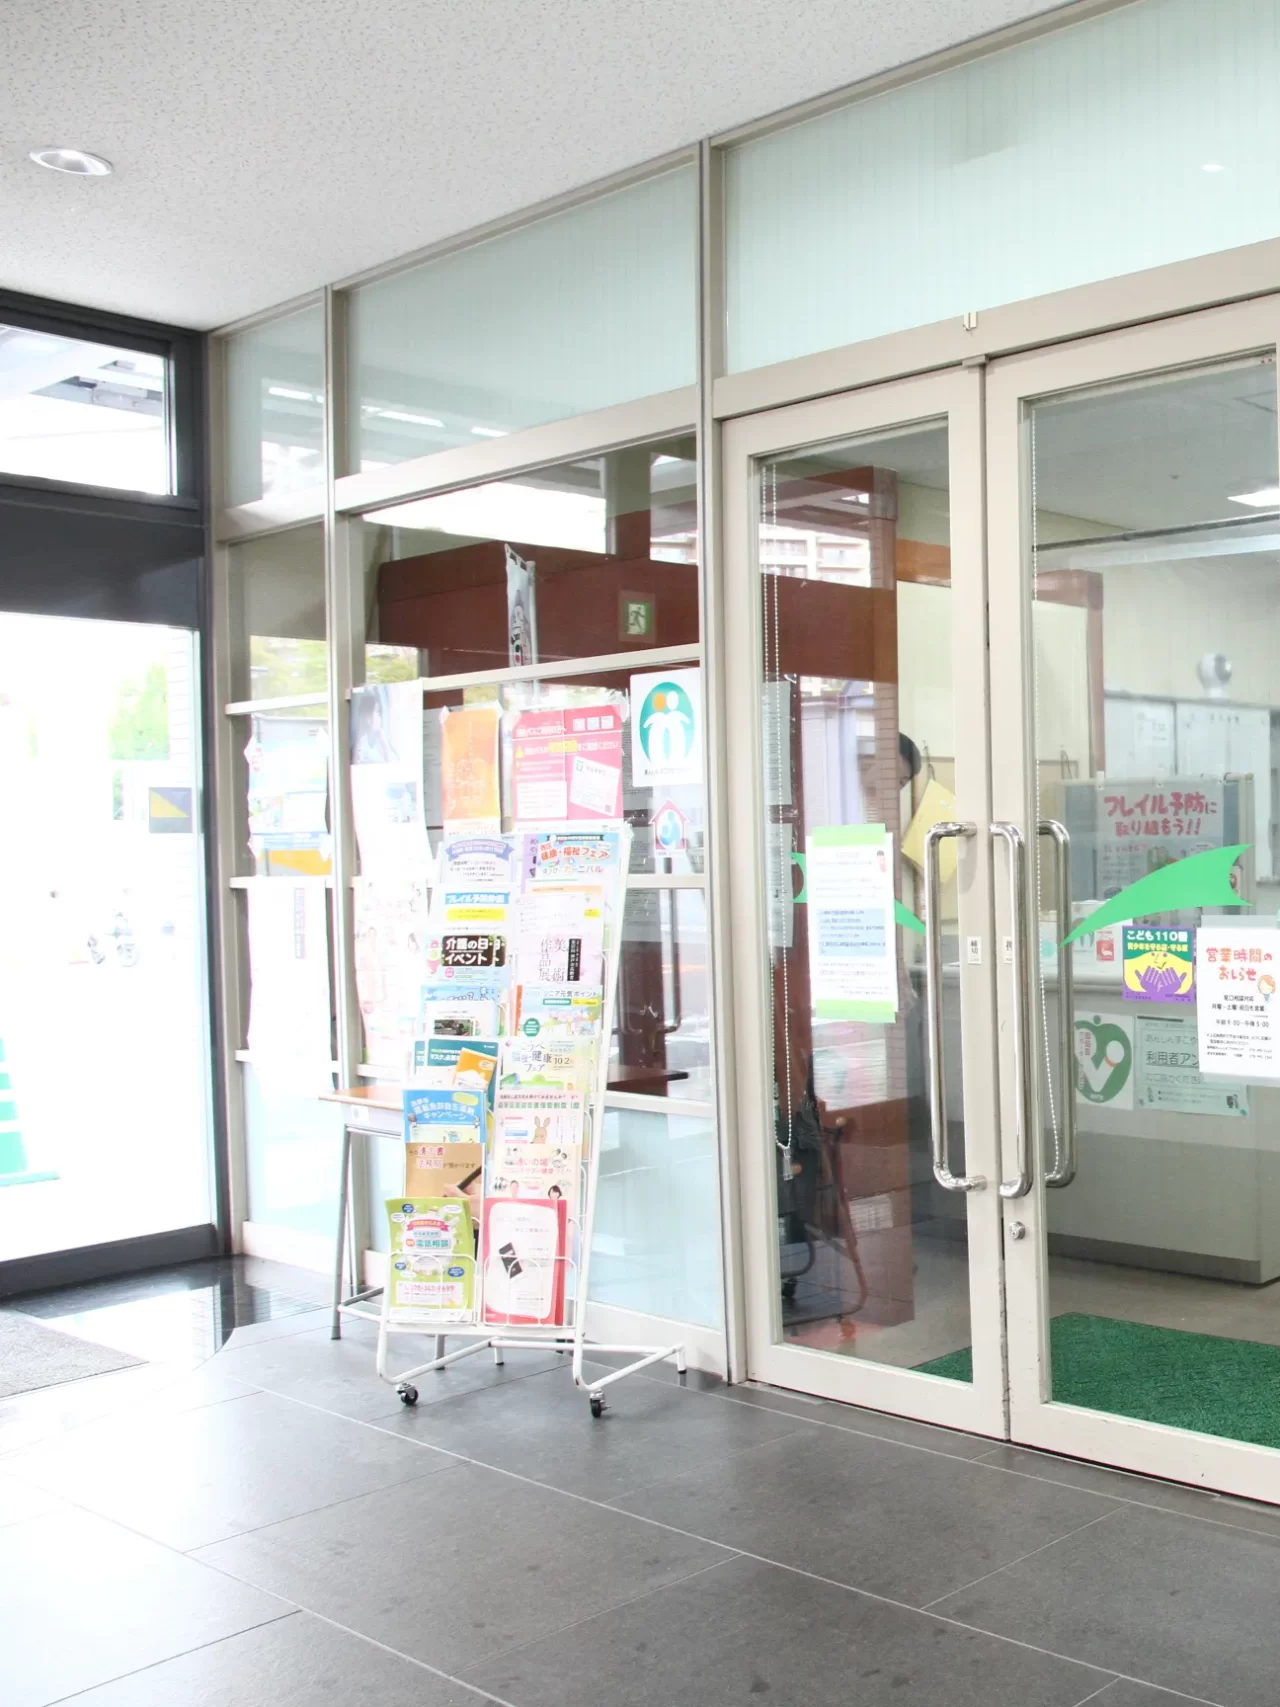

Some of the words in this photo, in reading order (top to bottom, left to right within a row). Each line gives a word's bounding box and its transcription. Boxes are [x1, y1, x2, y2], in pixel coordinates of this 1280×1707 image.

[1103, 791, 1218, 817] フレイル予防に
[445, 954, 487, 964] イベント
[1206, 946, 1273, 963] 営業時間の
[1218, 965, 1257, 982] おしらせ
